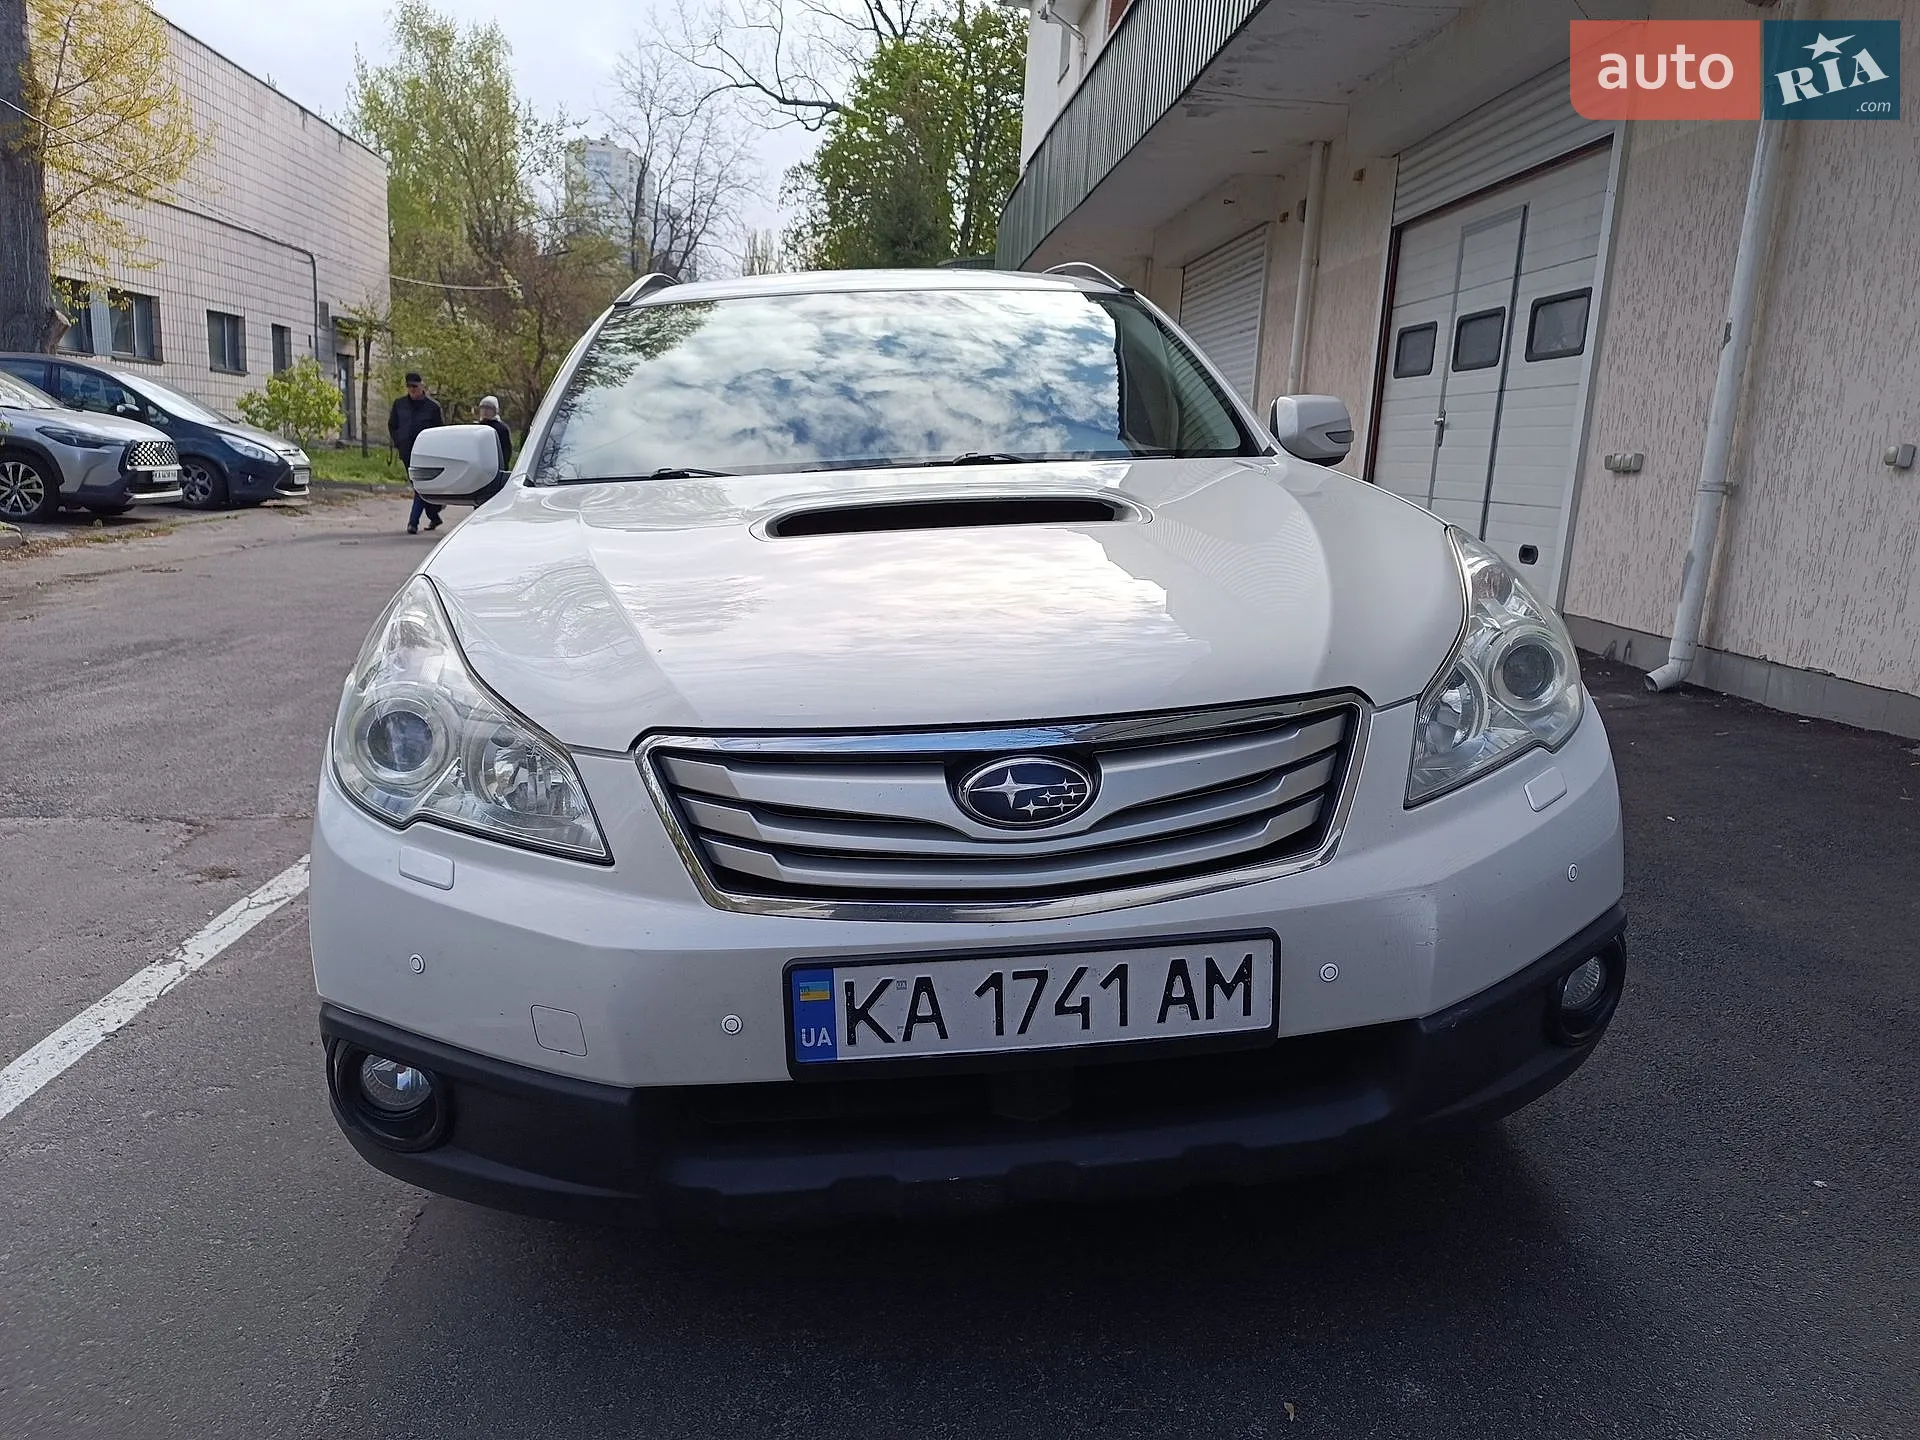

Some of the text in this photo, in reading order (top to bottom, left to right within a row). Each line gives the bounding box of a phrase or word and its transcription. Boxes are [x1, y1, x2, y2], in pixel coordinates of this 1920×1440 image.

[846, 954, 1253, 1045] KA 1741 AM
[801, 1027, 833, 1047] UA
